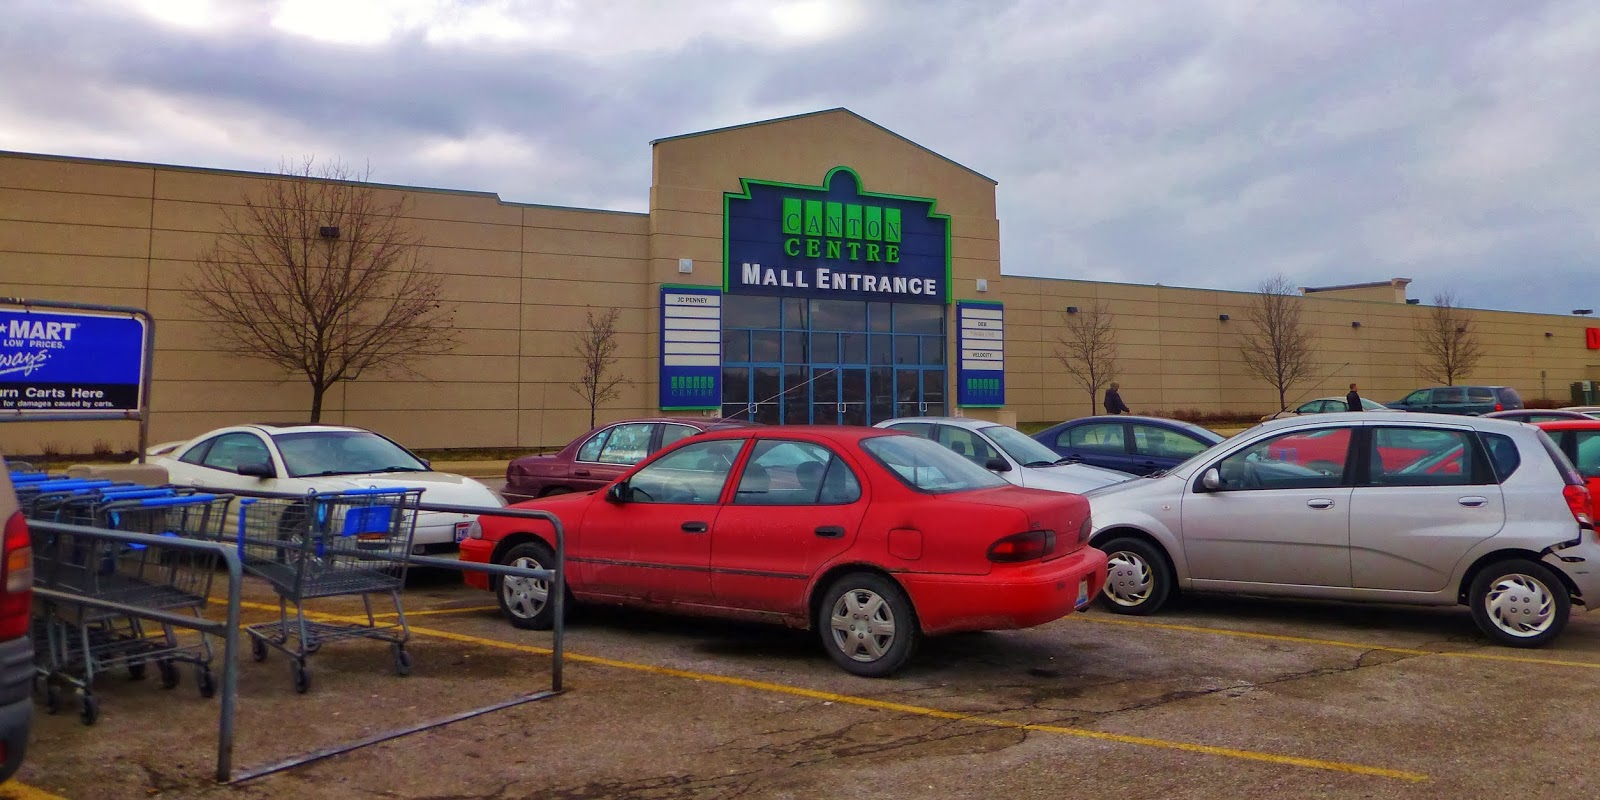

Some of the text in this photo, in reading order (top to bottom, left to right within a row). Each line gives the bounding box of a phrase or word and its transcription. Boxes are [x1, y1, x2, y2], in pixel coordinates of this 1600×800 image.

[786, 212, 900, 240] CANTON
[784, 238, 900, 263] CENTRE
[742, 262, 937, 295] MALL ENTRANCE
[9, 319, 77, 341] MART
[3, 339, 66, 349] LOW PRICES.
[25, 387, 66, 398] Carts
[71, 388, 104, 398] Here
[17, 400, 51, 408] damages
[82, 400, 92, 408] by
